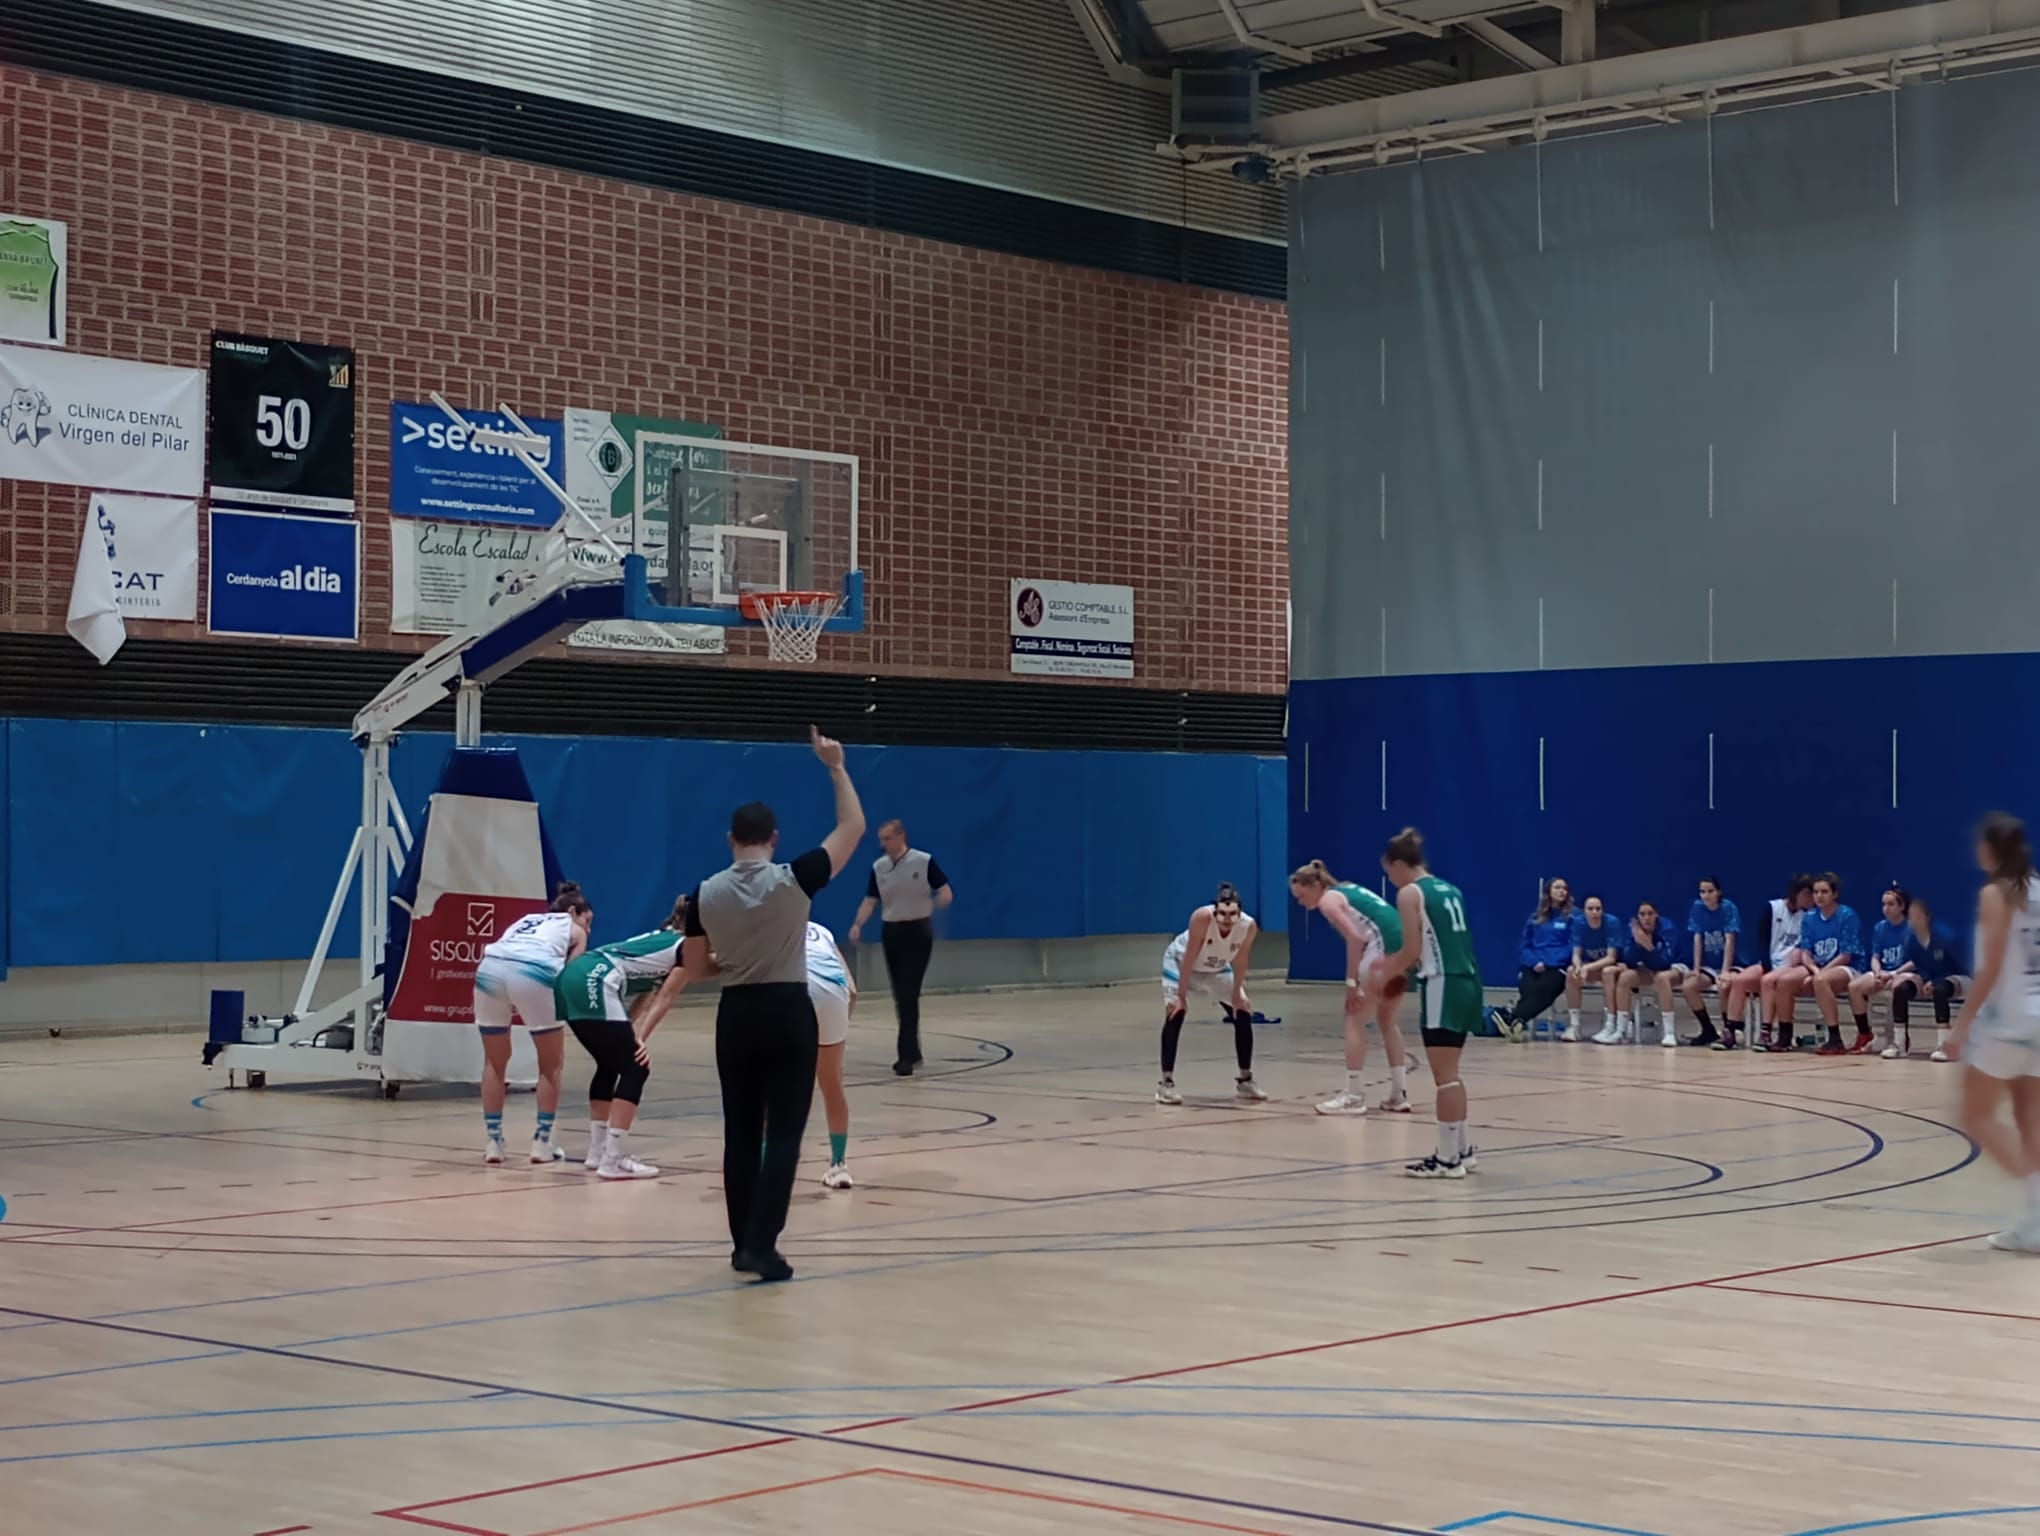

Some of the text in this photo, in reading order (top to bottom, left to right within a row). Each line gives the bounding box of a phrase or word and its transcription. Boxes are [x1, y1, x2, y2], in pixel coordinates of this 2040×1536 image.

[68, 403, 183, 429] CLÍNICA DENTAL
[256, 395, 311, 450] 50
[59, 422, 189, 451] Virgen del Pilar
[418, 523, 538, 562] Escola Escalad
[226, 564, 341, 593] Cerdanyola al dia
[1444, 896, 1467, 932] 11
[430, 939, 485, 963] SISQU
